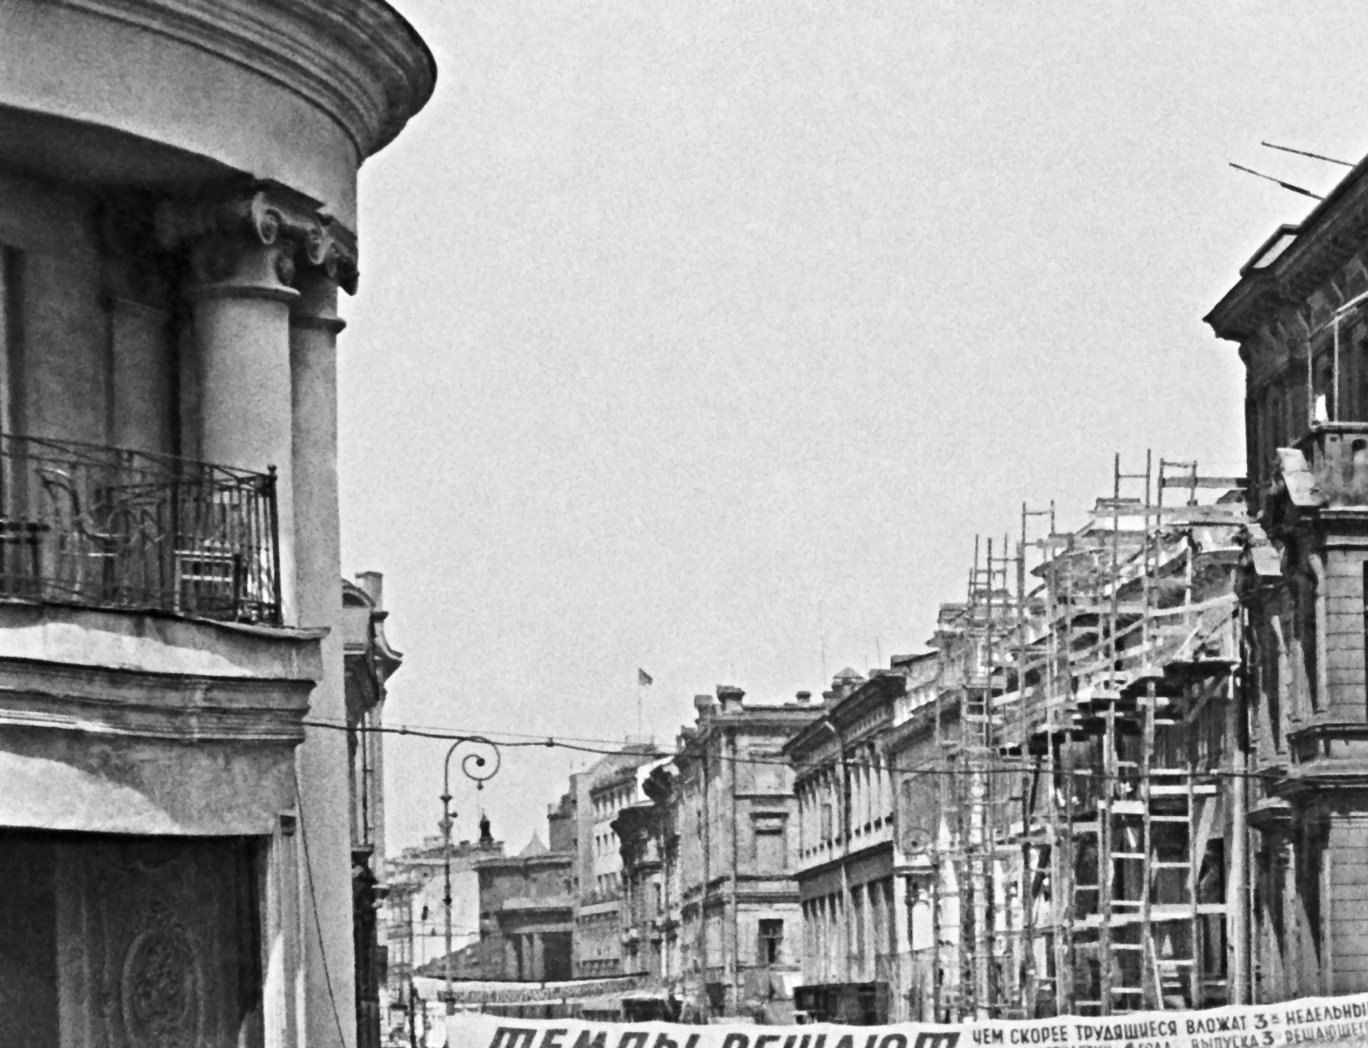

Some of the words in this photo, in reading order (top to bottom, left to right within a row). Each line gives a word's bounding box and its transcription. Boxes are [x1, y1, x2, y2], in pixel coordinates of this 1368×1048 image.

[973, 1027, 1003, 1045] ЧЕМ
[1010, 1024, 1068, 1044] СКОРЕЕ
[1074, 1020, 1178, 1043] ТРУДЯЩИЕСЯ
[1186, 1014, 1247, 1034] ВЛОЖАТ
